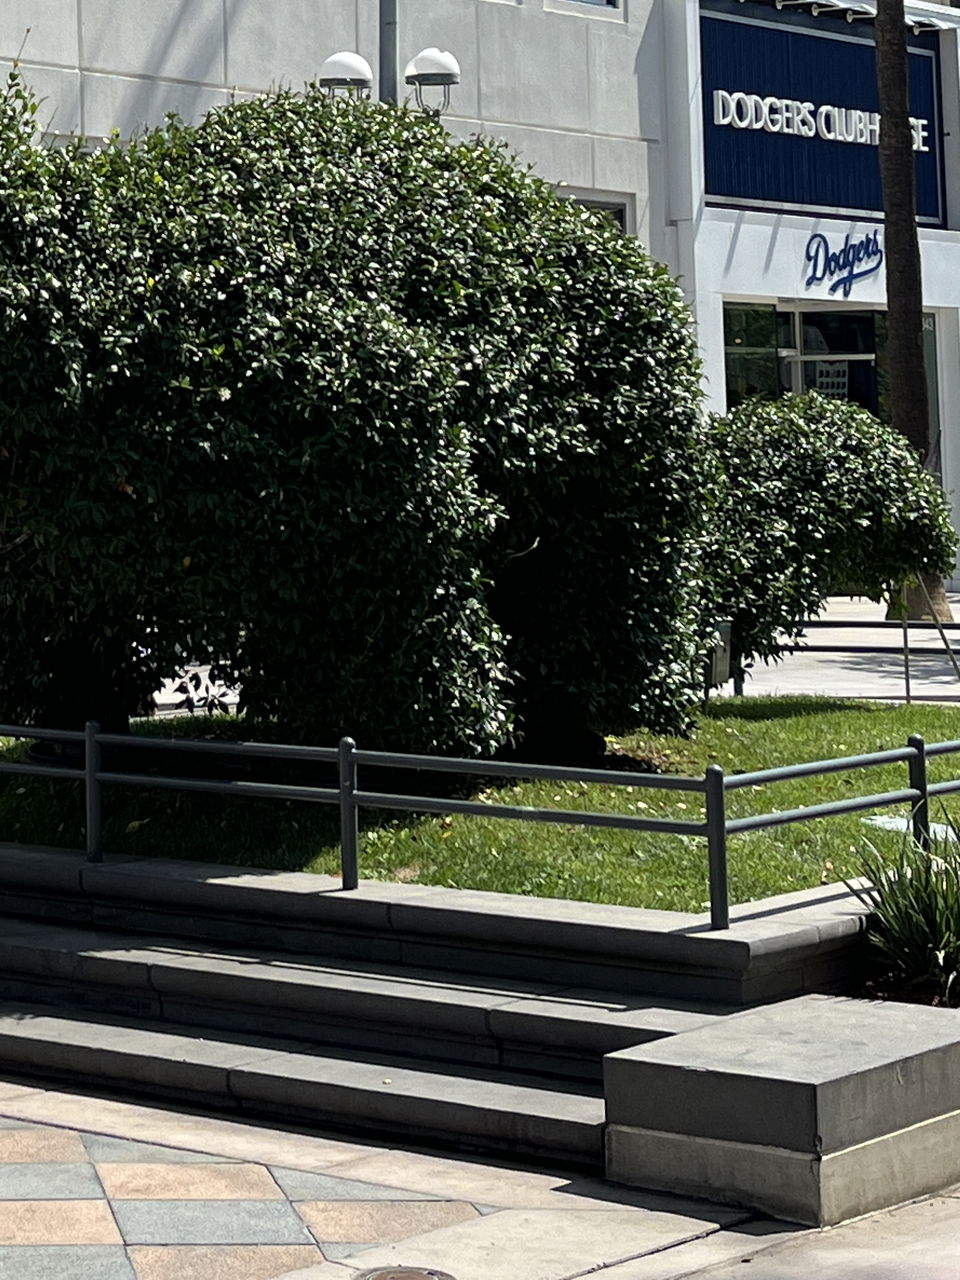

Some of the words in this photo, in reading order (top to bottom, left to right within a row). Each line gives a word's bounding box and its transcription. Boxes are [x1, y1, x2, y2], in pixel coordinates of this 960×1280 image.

[713, 90, 815, 137] DODGERS
[817, 105, 929, 151] CLUBHSE
[806, 229, 883, 297] Dodgers
